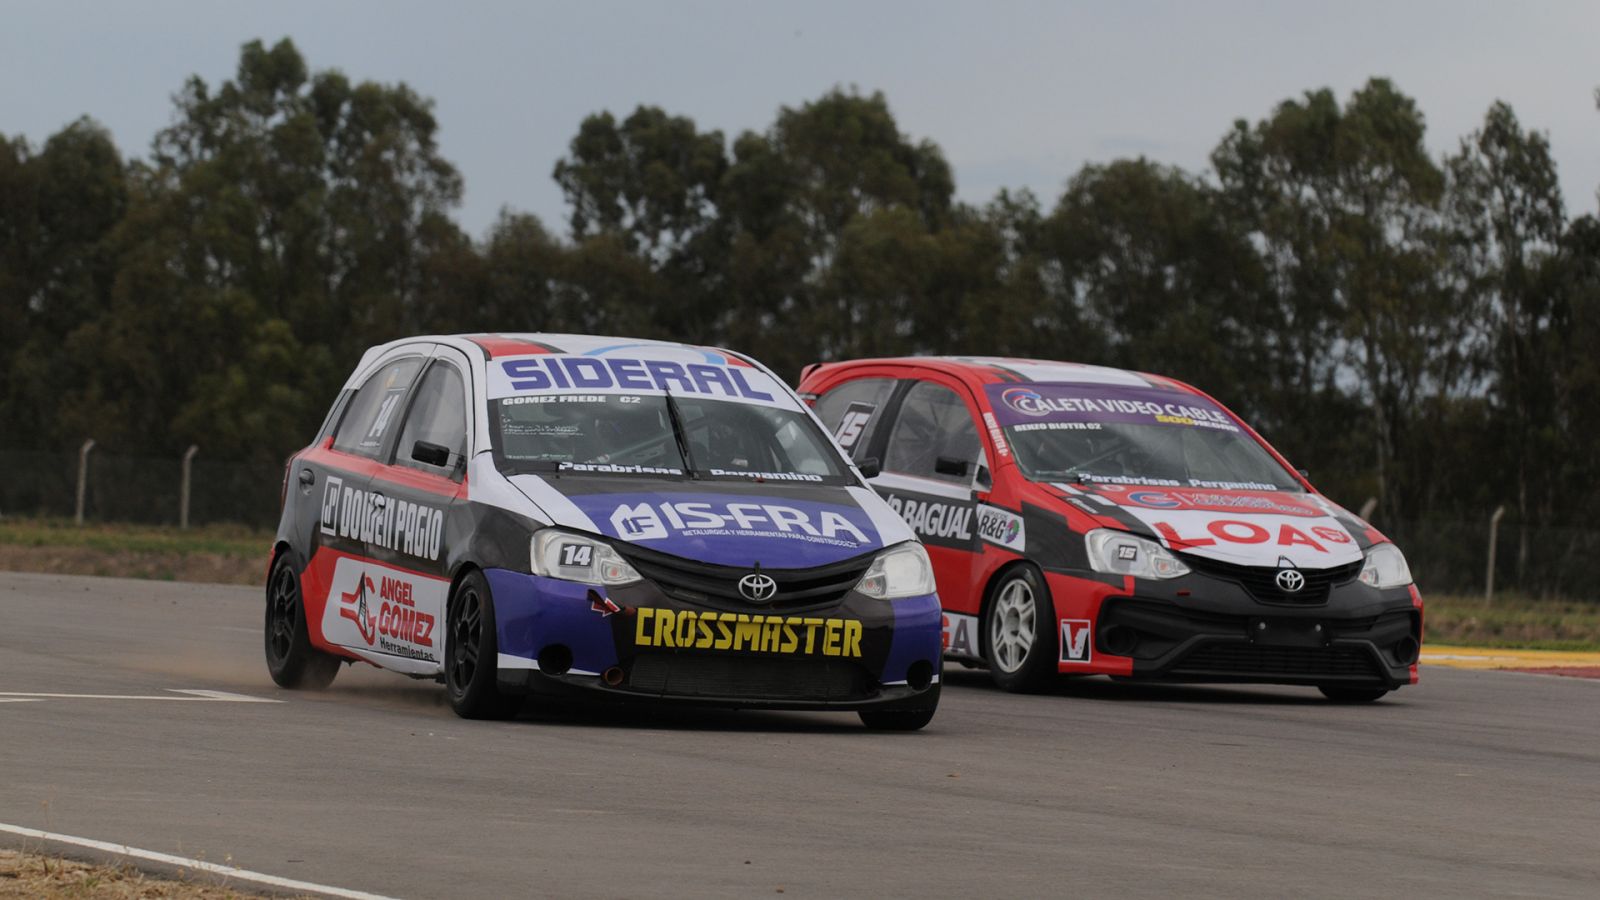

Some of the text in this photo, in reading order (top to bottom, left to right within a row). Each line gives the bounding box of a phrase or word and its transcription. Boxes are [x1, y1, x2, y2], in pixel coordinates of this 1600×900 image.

[501, 357, 775, 402] SIDERAL
[502, 395, 641, 406] GOMEZ FREDE C2
[1019, 398, 1230, 424] CALETA VIDEO CABLE
[368, 393, 400, 438] 14
[1014, 423, 1047, 432] RENZO
[1047, 422, 1086, 431] BLOTTA
[834, 411, 871, 447] 15
[559, 461, 823, 482] Parabrisas Pergamino
[1078, 473, 1278, 491] Parabrisas Pergamino
[394, 500, 443, 561] PAGIO
[659, 502, 872, 543] IS-FRA
[903, 500, 973, 541] BAGUAL
[980, 514, 1007, 540] R&G
[735, 530, 787, 538] HERRAMIENTAS
[788, 533, 807, 541] PARA
[563, 545, 592, 566] 14
[1118, 546, 1136, 559] 15
[380, 576, 415, 607] ANGEL
[379, 601, 435, 648] GOMEZ
[635, 607, 862, 657] CROSSMASTER
[380, 637, 434, 661] Herramientas
